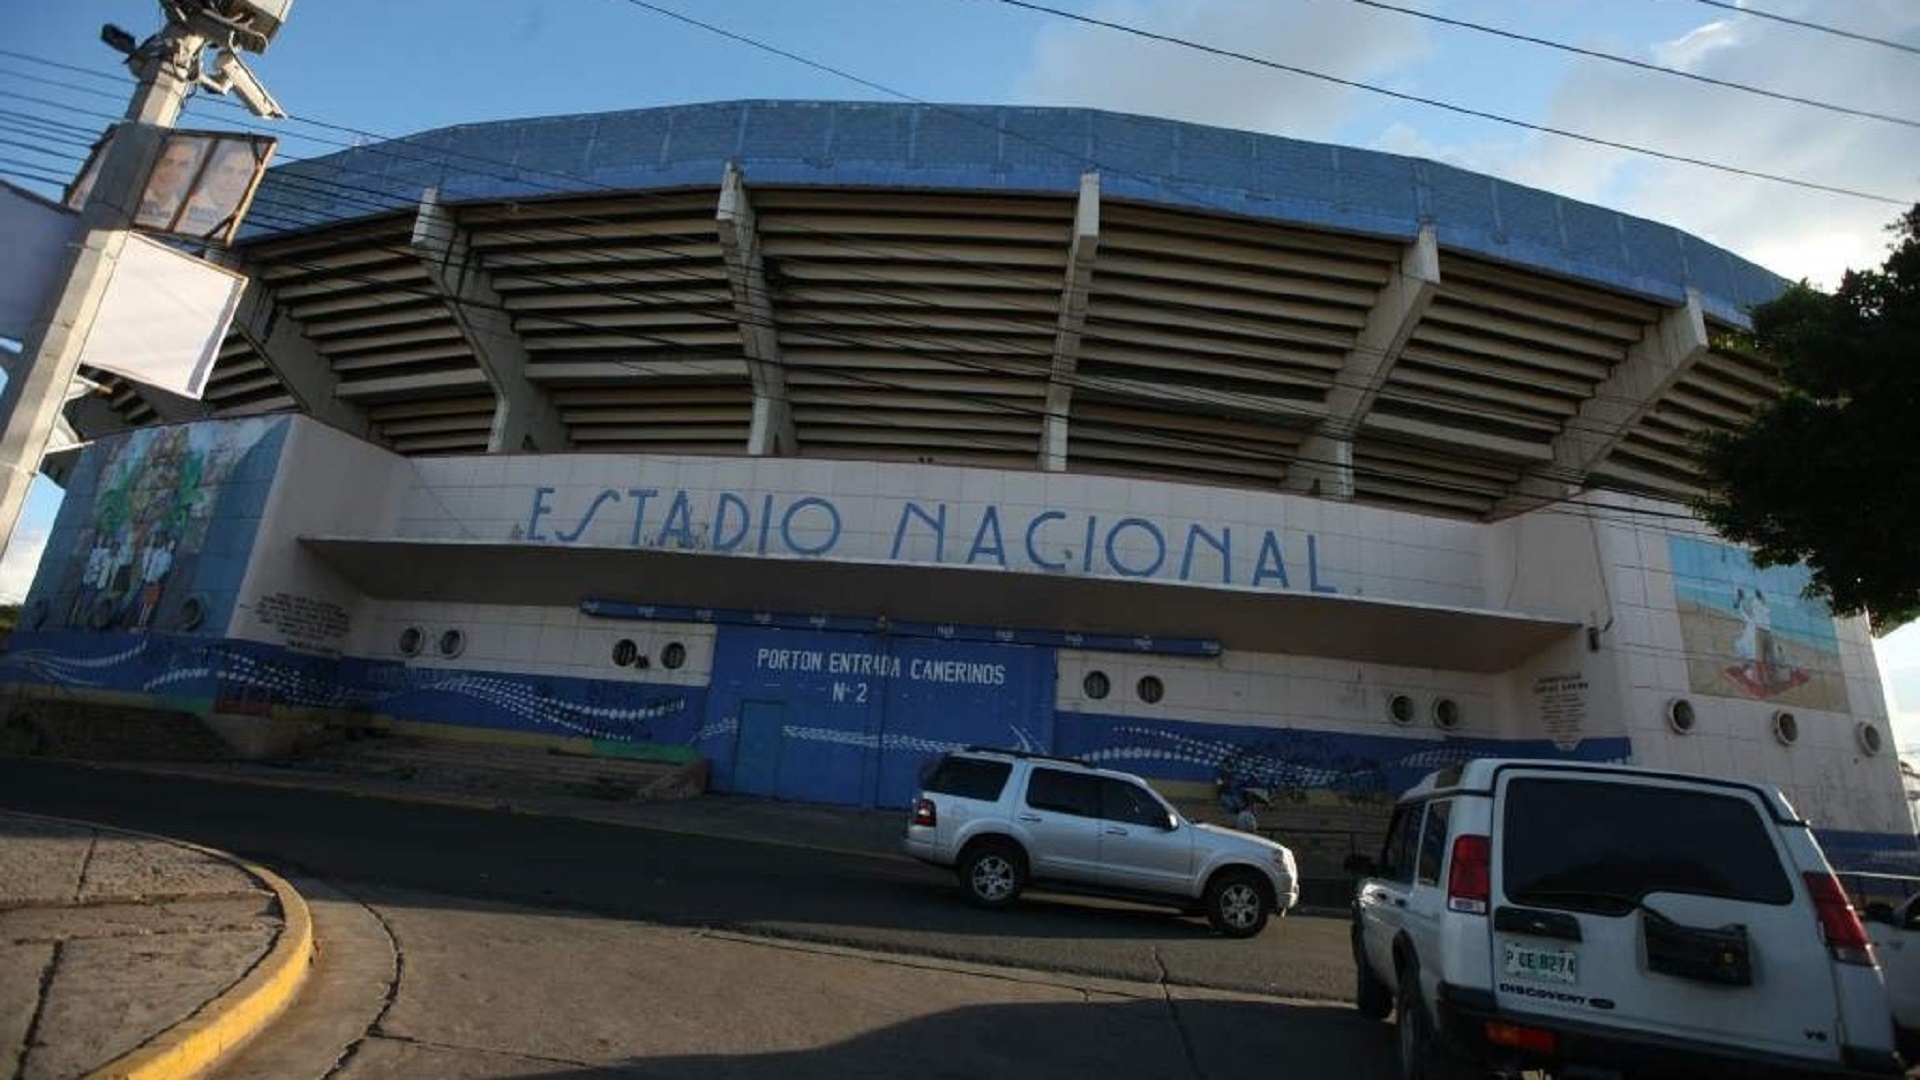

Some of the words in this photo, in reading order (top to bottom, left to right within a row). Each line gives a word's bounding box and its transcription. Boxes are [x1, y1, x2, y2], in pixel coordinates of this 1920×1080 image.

[526, 486, 842, 556] ESTADIO
[890, 502, 1337, 593] NACIONAL
[757, 648, 822, 672] PORTON
[828, 652, 900, 678] ENTRADA
[910, 657, 1006, 686] CAMERINOS
[1500, 983, 1585, 1005] DISCOVERY
